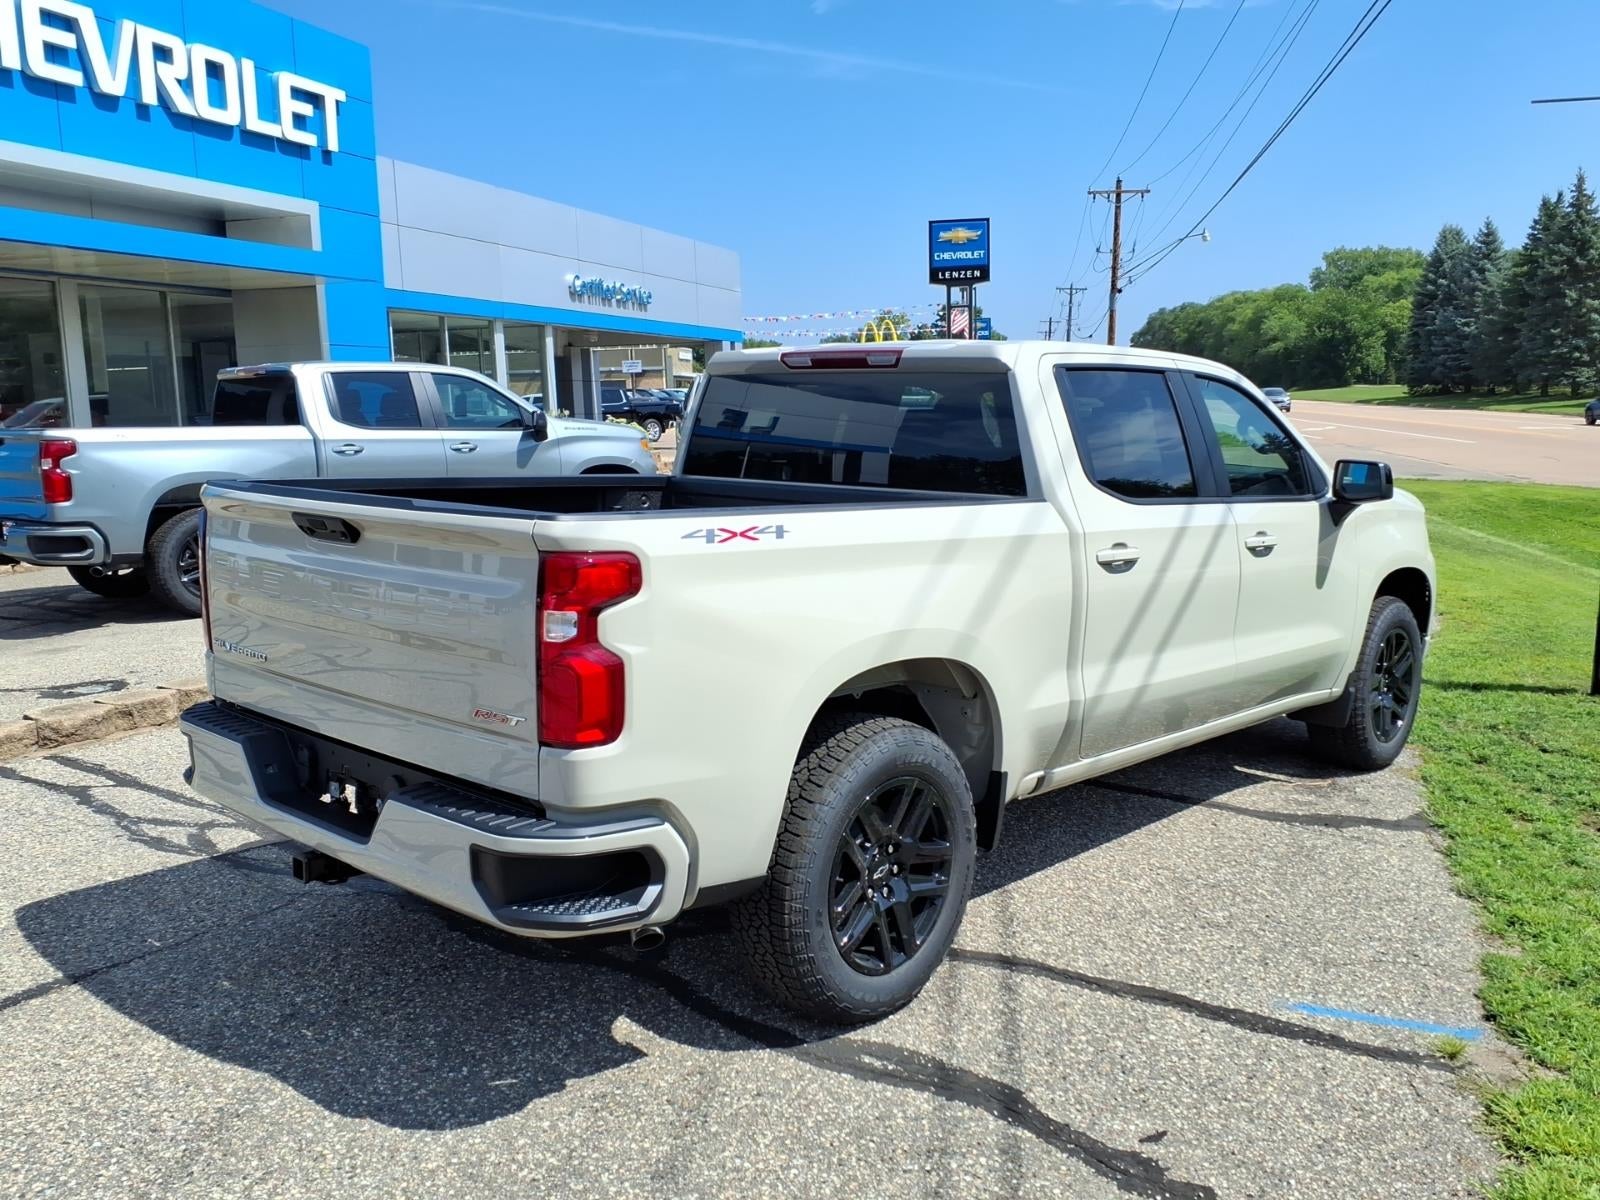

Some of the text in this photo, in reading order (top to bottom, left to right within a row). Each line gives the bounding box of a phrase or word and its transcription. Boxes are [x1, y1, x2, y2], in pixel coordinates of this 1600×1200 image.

[934, 250, 985, 261] CHEVROLET
[938, 270, 981, 279] LENZEN
[568, 274, 652, 305] Certified Service
[473, 708, 527, 726] RST
